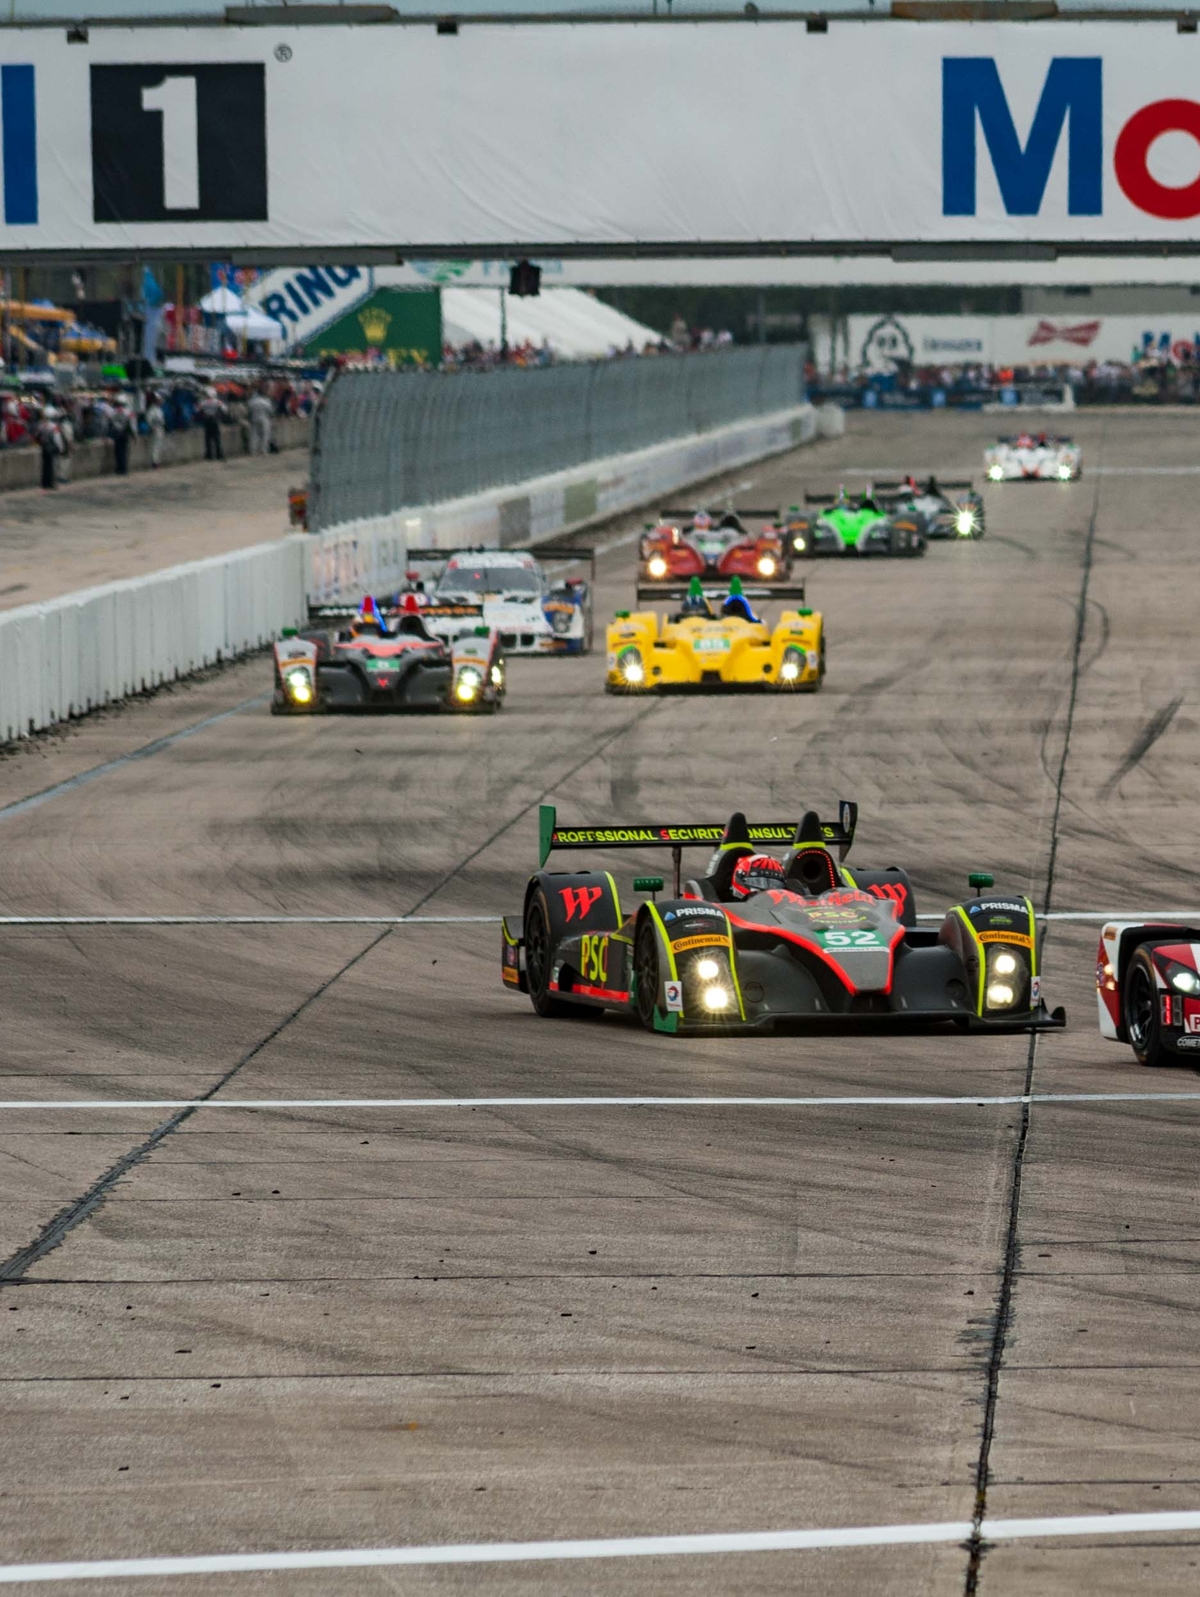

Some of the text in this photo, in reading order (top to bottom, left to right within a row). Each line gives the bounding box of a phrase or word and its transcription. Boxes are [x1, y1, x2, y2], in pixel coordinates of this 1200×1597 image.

[142, 75, 200, 210] 1
[675, 907, 725, 919] PRISMA
[980, 902, 1029, 915] PRISMA
[673, 936, 721, 951] Continental
[825, 931, 880, 946] 52
[979, 931, 1025, 943] Continental
